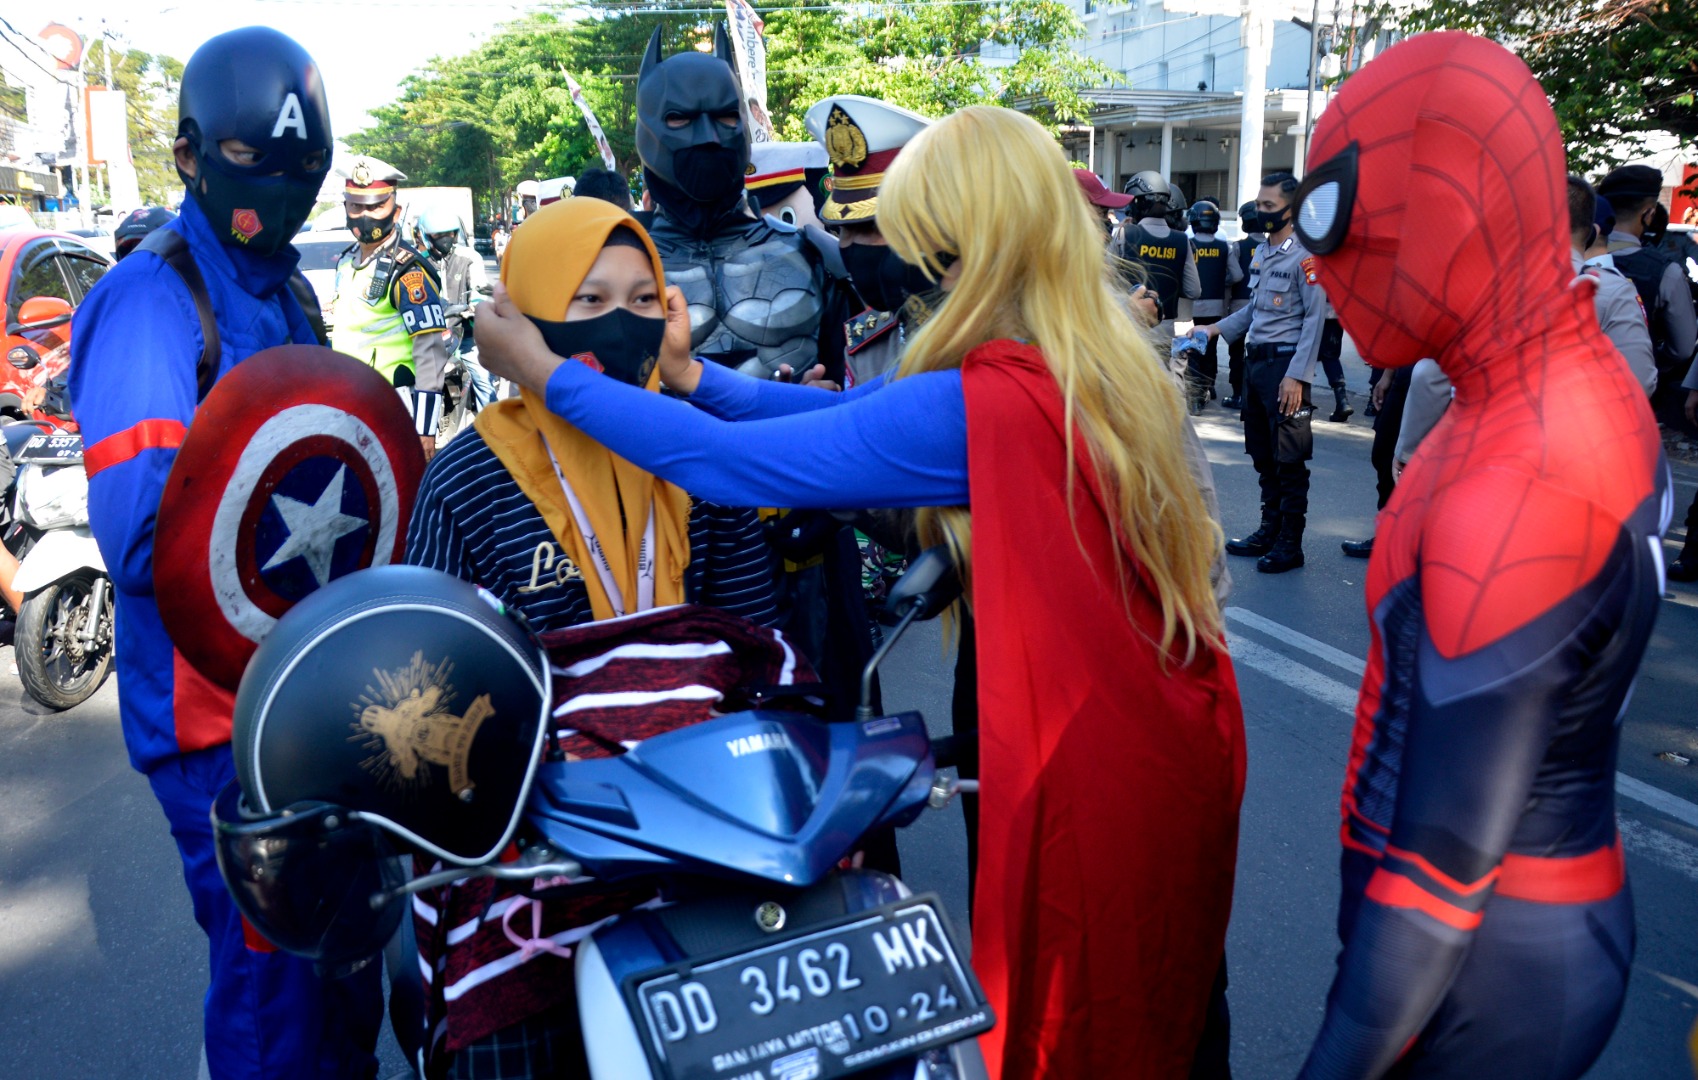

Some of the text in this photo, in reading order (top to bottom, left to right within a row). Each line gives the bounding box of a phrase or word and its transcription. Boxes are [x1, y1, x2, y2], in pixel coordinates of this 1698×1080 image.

[271, 92, 308, 140] A
[231, 227, 250, 244] TNI
[1140, 244, 1177, 260] POLISI
[1270, 271, 1292, 279] POLRI
[402, 304, 446, 335] PJR
[650, 982, 718, 1042] DD
[740, 942, 862, 1015] 3462
[872, 917, 944, 975] MK
